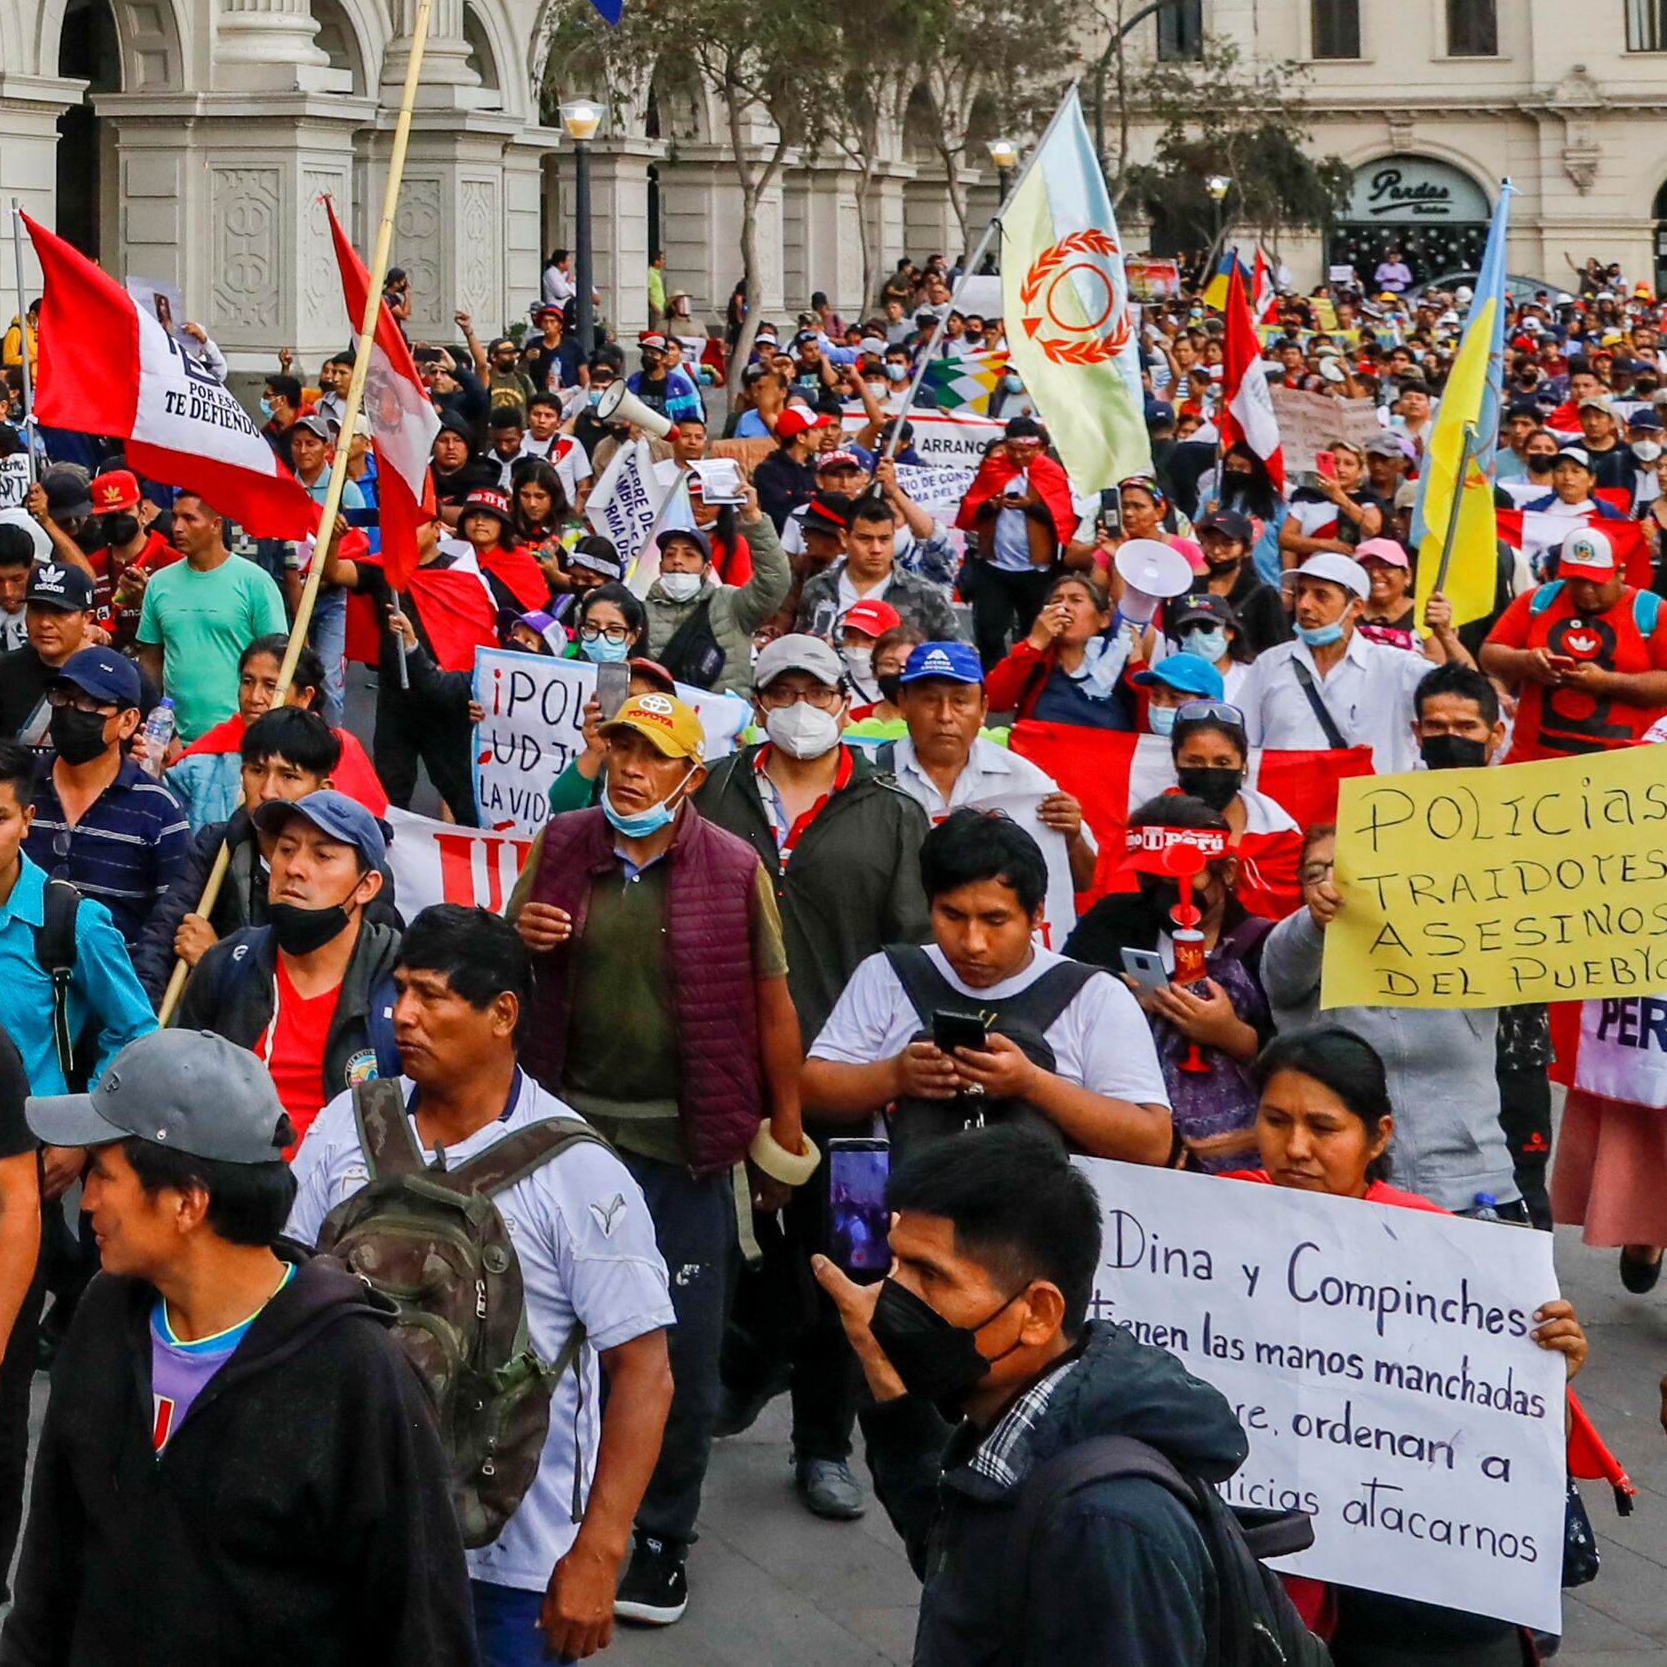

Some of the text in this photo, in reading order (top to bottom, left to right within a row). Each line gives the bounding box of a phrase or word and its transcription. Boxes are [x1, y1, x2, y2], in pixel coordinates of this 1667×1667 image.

[165, 389, 186, 416] TE
[189, 380, 241, 412] POR ESO
[34, 582, 66, 594] adidas
[494, 669, 582, 731] ¡POL
[628, 710, 674, 729] TOYOTA
[480, 774, 551, 823] LA VID
[1374, 966, 1485, 996] DEL
[1106, 1209, 1530, 1337] Dina y Compinches
[1203, 1311, 1246, 1362] las
[1255, 1340, 1364, 1381] manos
[1373, 1354, 1547, 1419] manchadas
[1292, 1400, 1455, 1469] ordenan
[1480, 1454, 1511, 1483] a
[1341, 1476, 1539, 1563] atacarnos
